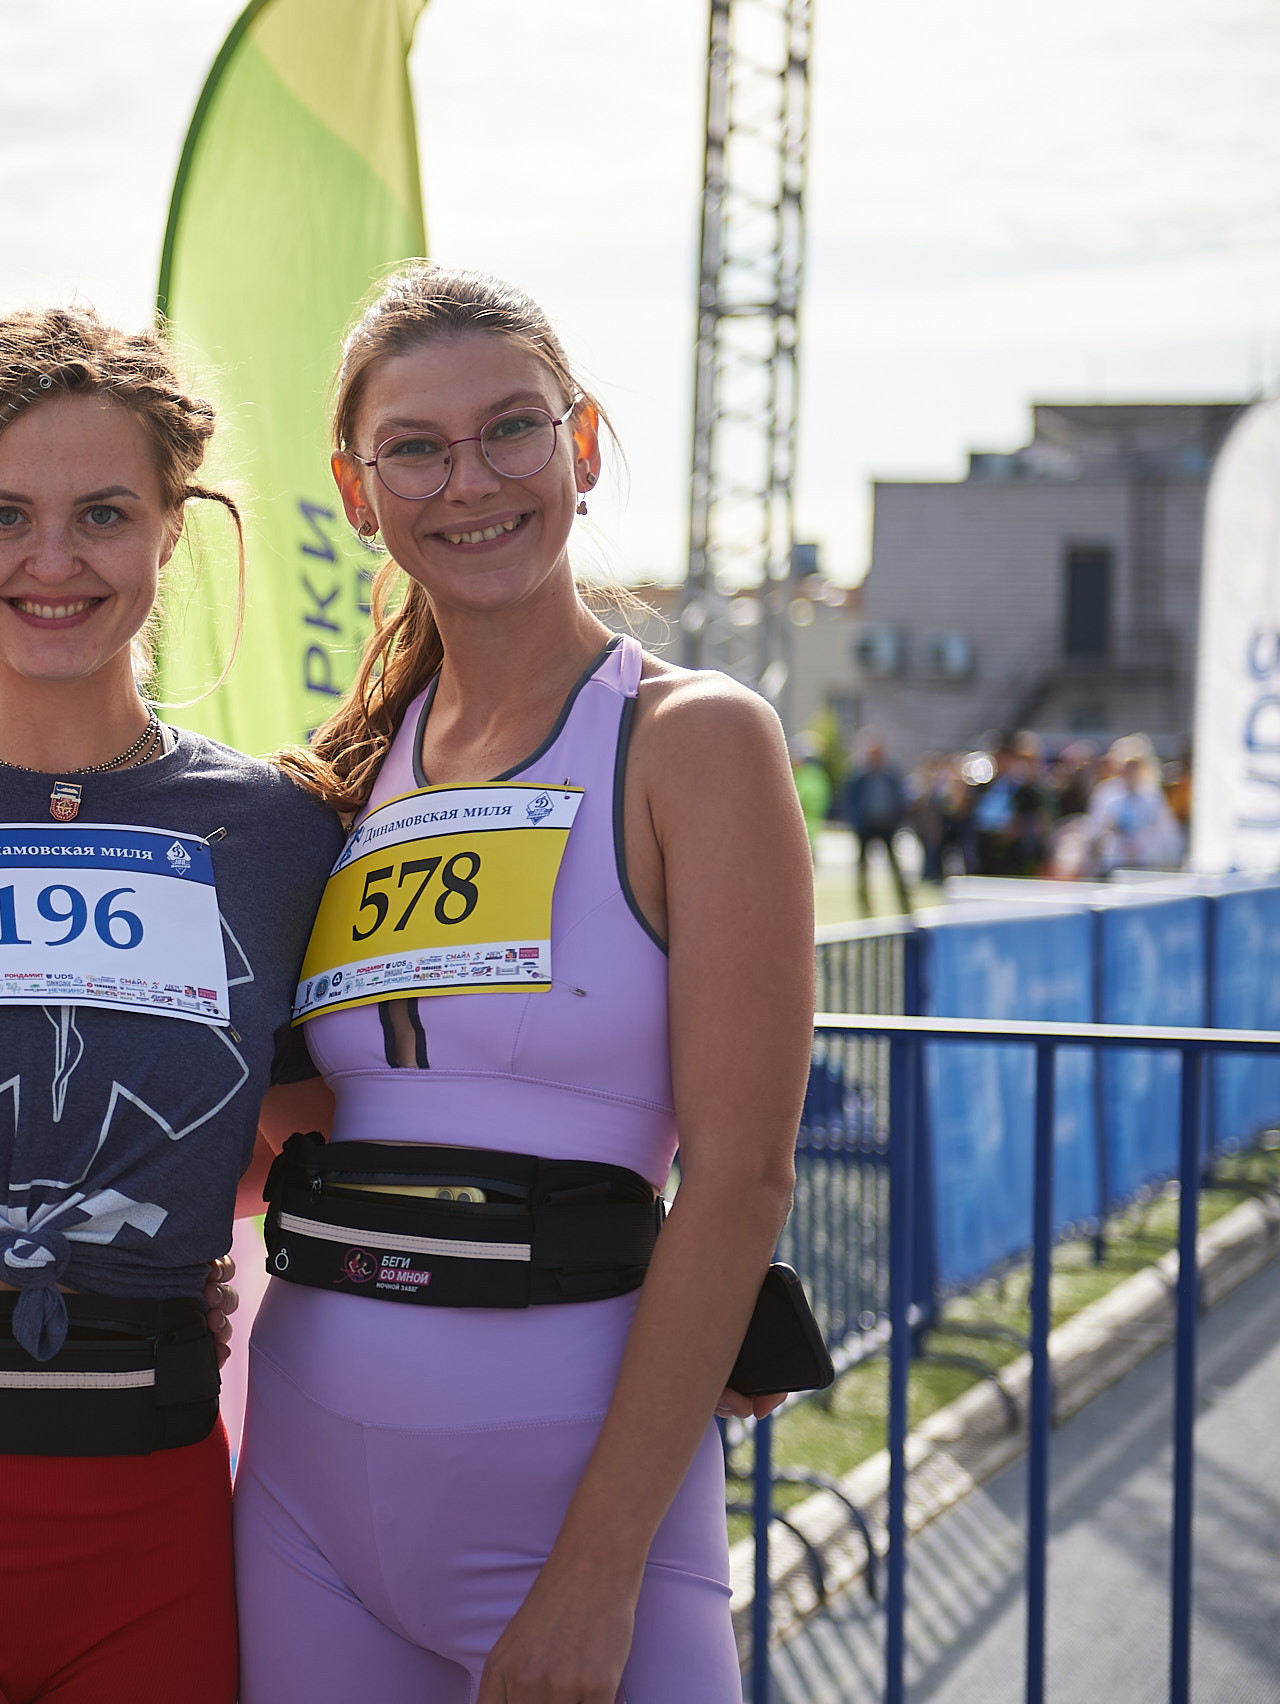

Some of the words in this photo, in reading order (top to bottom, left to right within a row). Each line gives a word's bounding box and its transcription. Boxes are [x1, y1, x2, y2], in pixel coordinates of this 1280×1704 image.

[299, 497, 344, 745] РКИ
[363, 808, 458, 844] Динамовская
[462, 802, 513, 819] миля
[100, 846, 153, 861] миля
[352, 851, 481, 942] 578
[392, 960, 407, 968] UDS
[381, 1255, 411, 1269] БЕГИ
[380, 1269, 395, 1280] СО
[397, 1271, 429, 1284] МНОЙ
